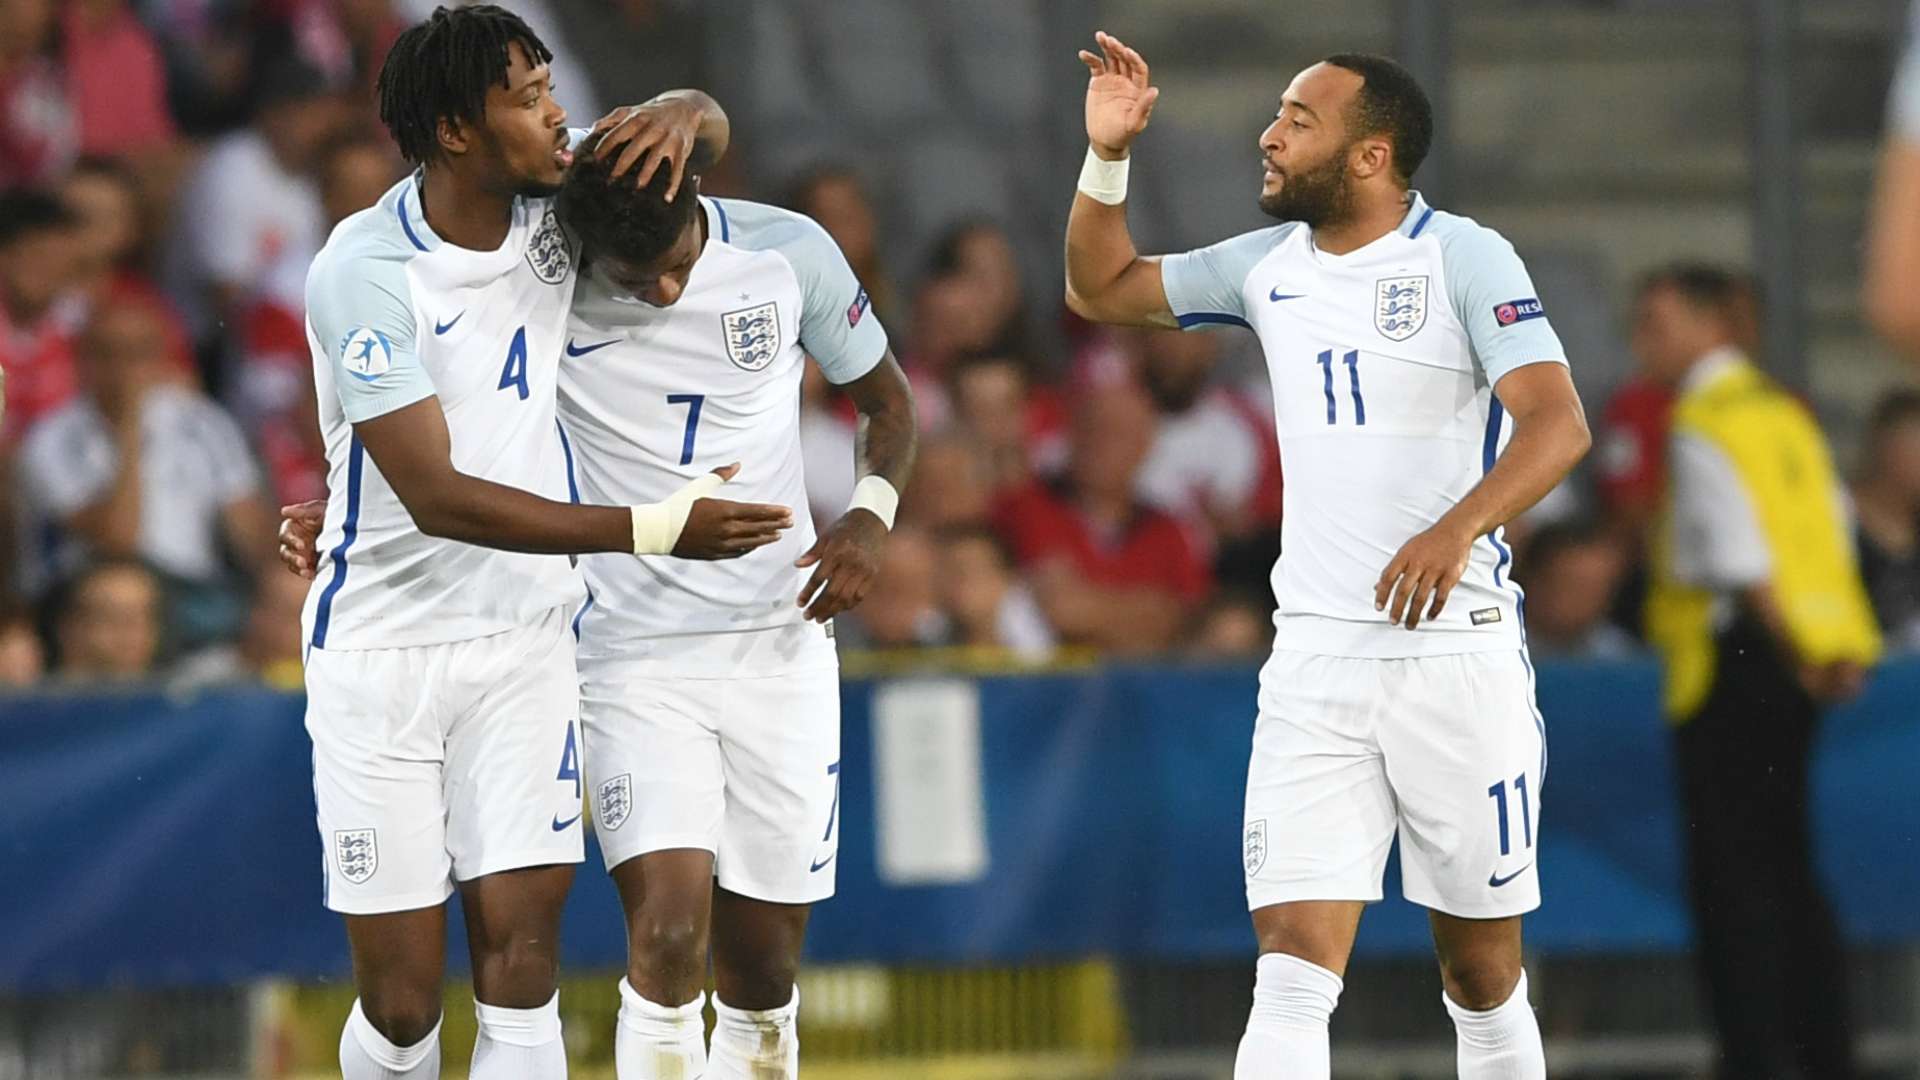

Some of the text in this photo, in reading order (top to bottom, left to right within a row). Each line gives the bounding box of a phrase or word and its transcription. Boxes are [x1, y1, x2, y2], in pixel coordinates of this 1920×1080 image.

[498, 325, 530, 401] 4
[1317, 348, 1365, 425] 11
[667, 394, 705, 465] 7
[556, 719, 581, 799] 4
[1488, 771, 1531, 856] 11
